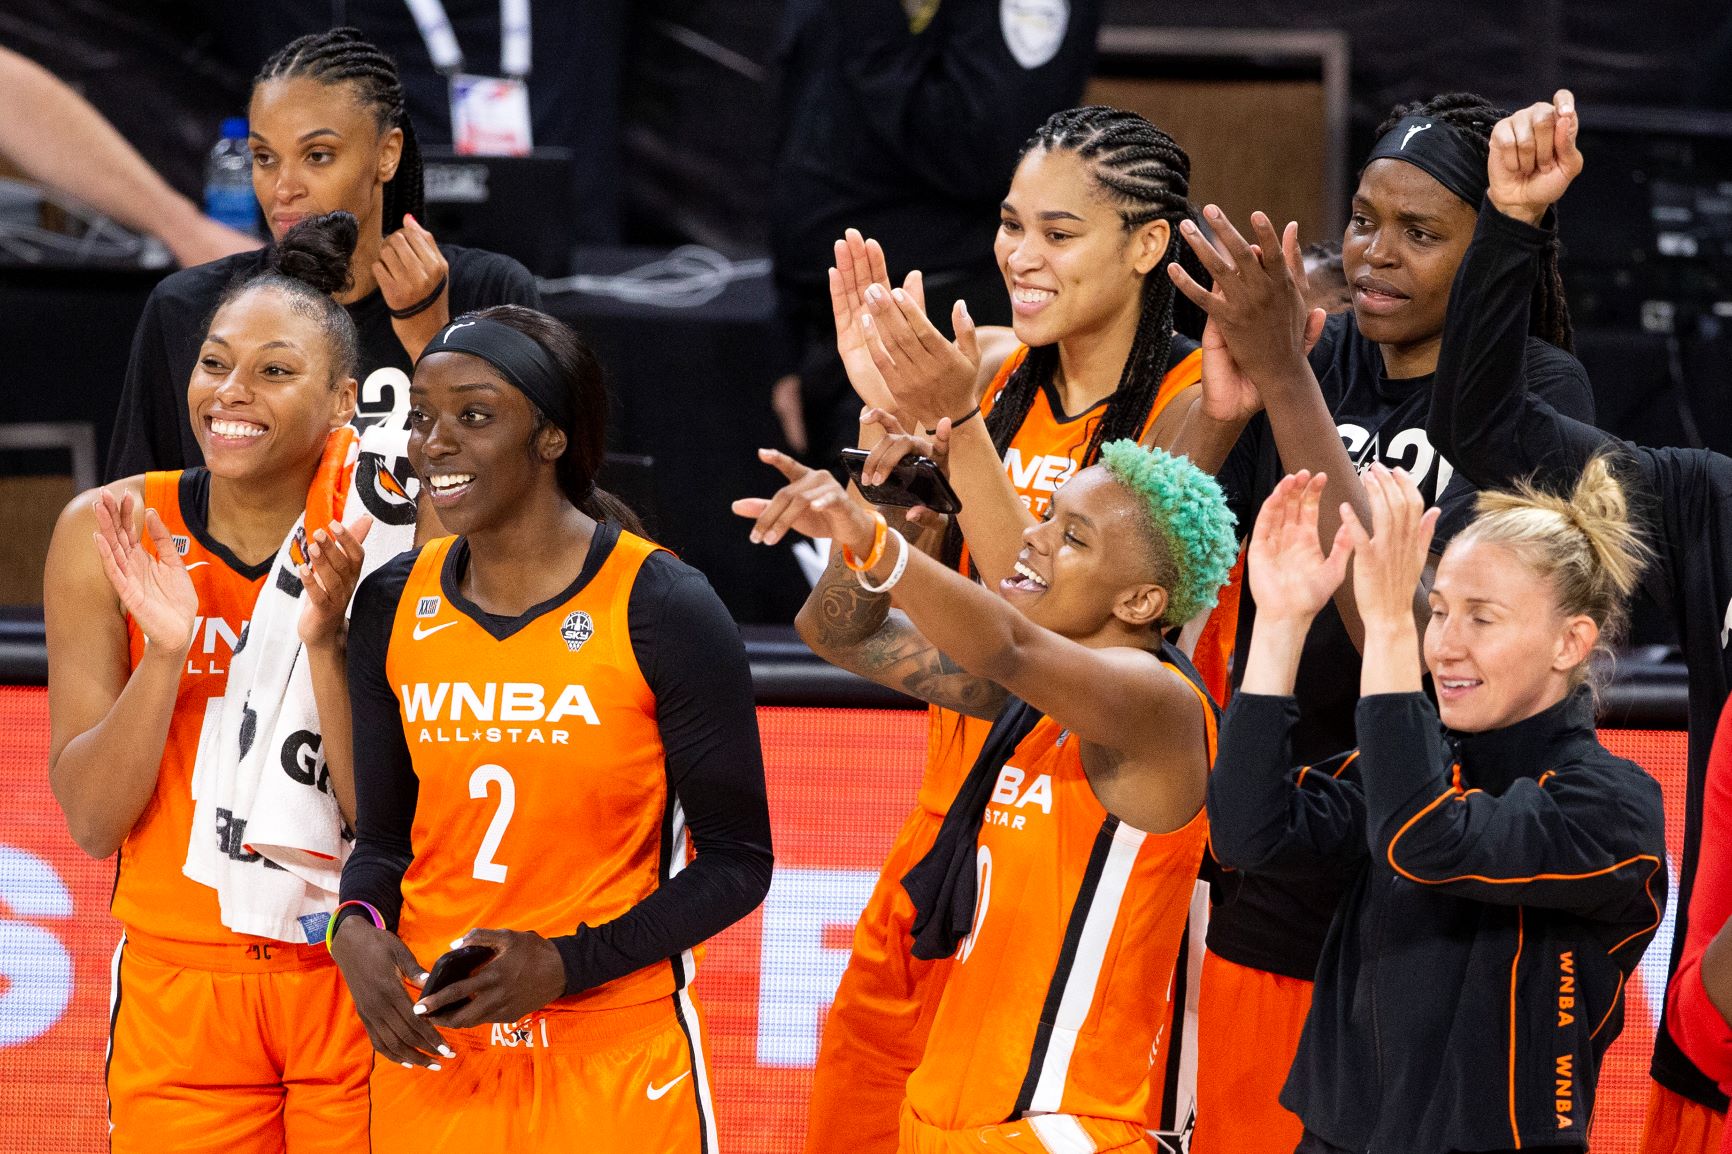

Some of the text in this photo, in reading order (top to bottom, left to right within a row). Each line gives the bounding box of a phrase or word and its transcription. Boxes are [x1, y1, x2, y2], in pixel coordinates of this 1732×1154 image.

[564, 631, 589, 640] SKY
[401, 682, 601, 725] WNBA
[419, 727, 570, 745] ALL STAR
[468, 764, 516, 884] 2
[985, 808, 1026, 831] STAR
[1555, 951, 1576, 1129] WNBA WNBA
